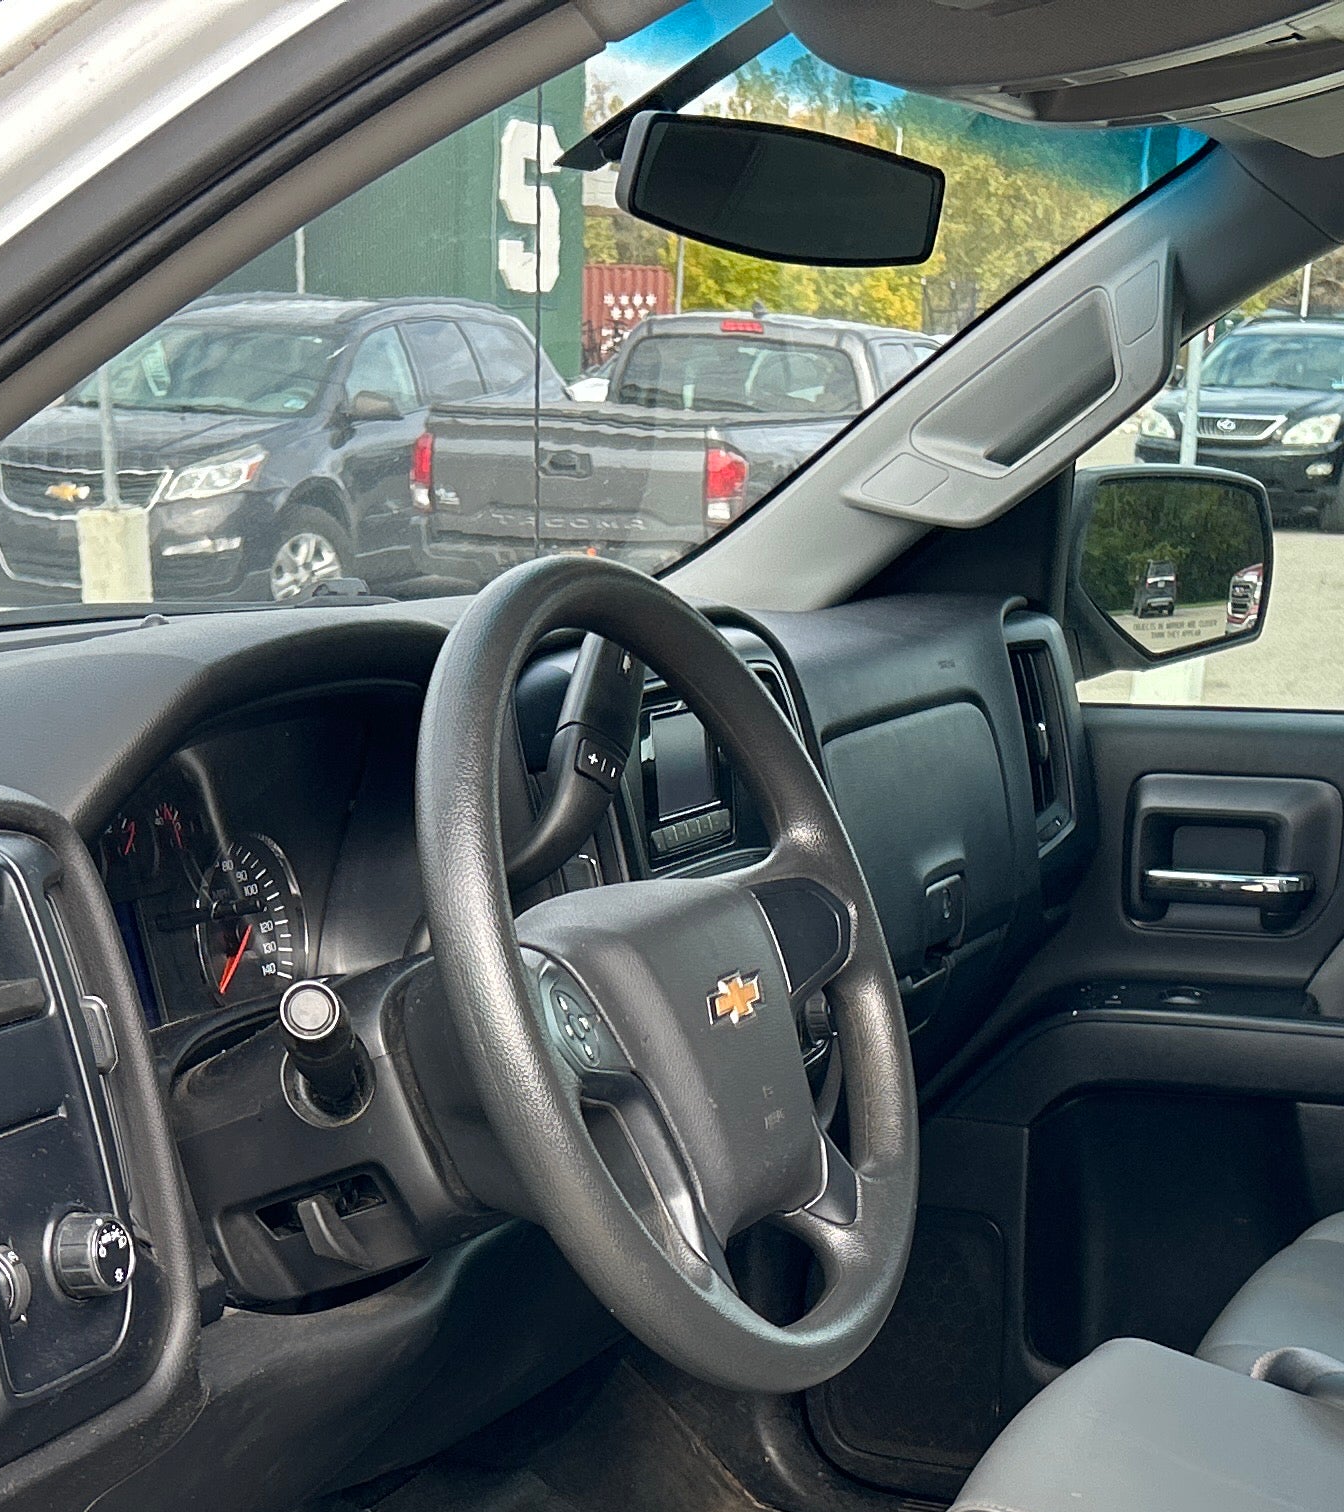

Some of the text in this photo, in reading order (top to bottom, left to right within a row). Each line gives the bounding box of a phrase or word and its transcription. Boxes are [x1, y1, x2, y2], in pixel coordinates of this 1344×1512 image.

[222, 859, 233, 872] 80
[236, 869, 248, 883] 90
[243, 883, 258, 897] 100
[260, 920, 274, 934] 120
[262, 941, 277, 954] 130
[262, 962, 276, 977] 140
